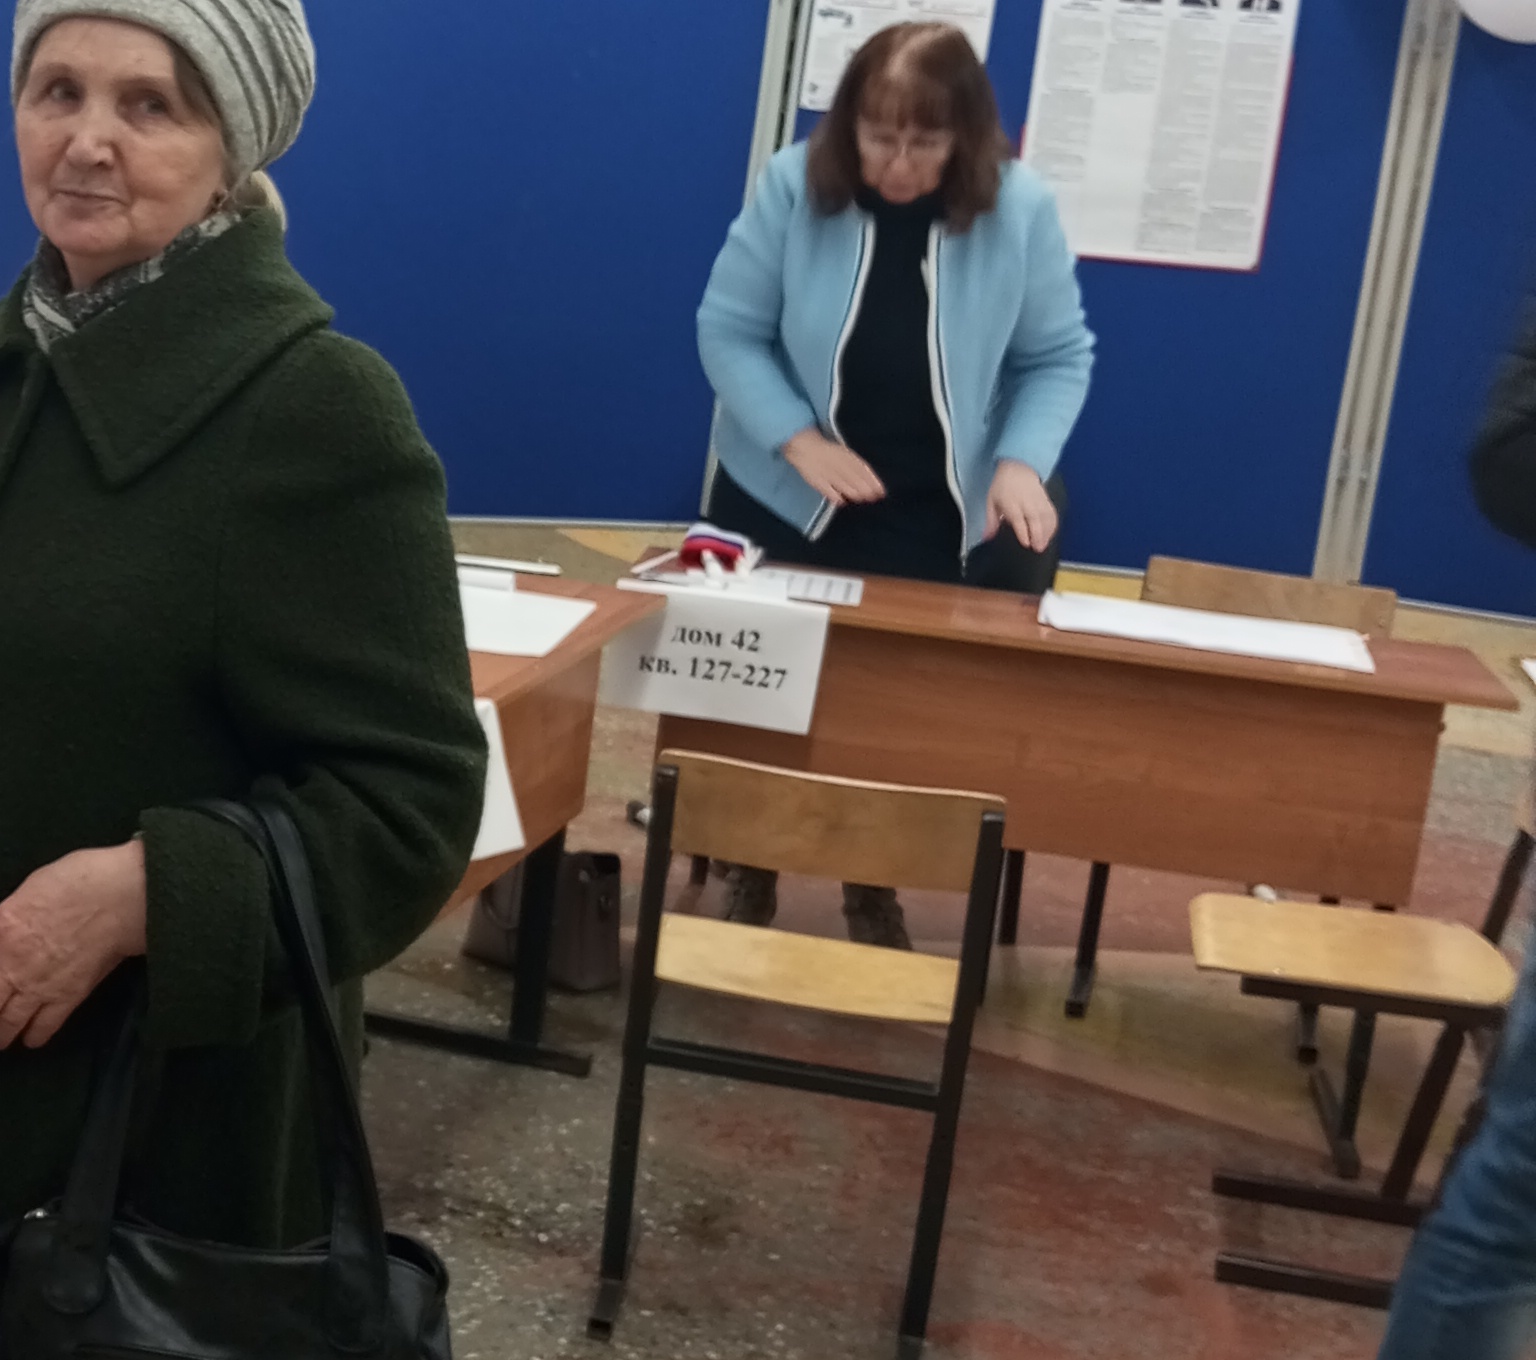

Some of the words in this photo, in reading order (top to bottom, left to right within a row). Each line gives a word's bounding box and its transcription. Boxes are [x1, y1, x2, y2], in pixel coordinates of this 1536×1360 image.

[672, 627, 721, 647] дом
[730, 629, 760, 652] 42
[639, 655, 677, 675] кв.
[690, 657, 787, 690] 127-227
